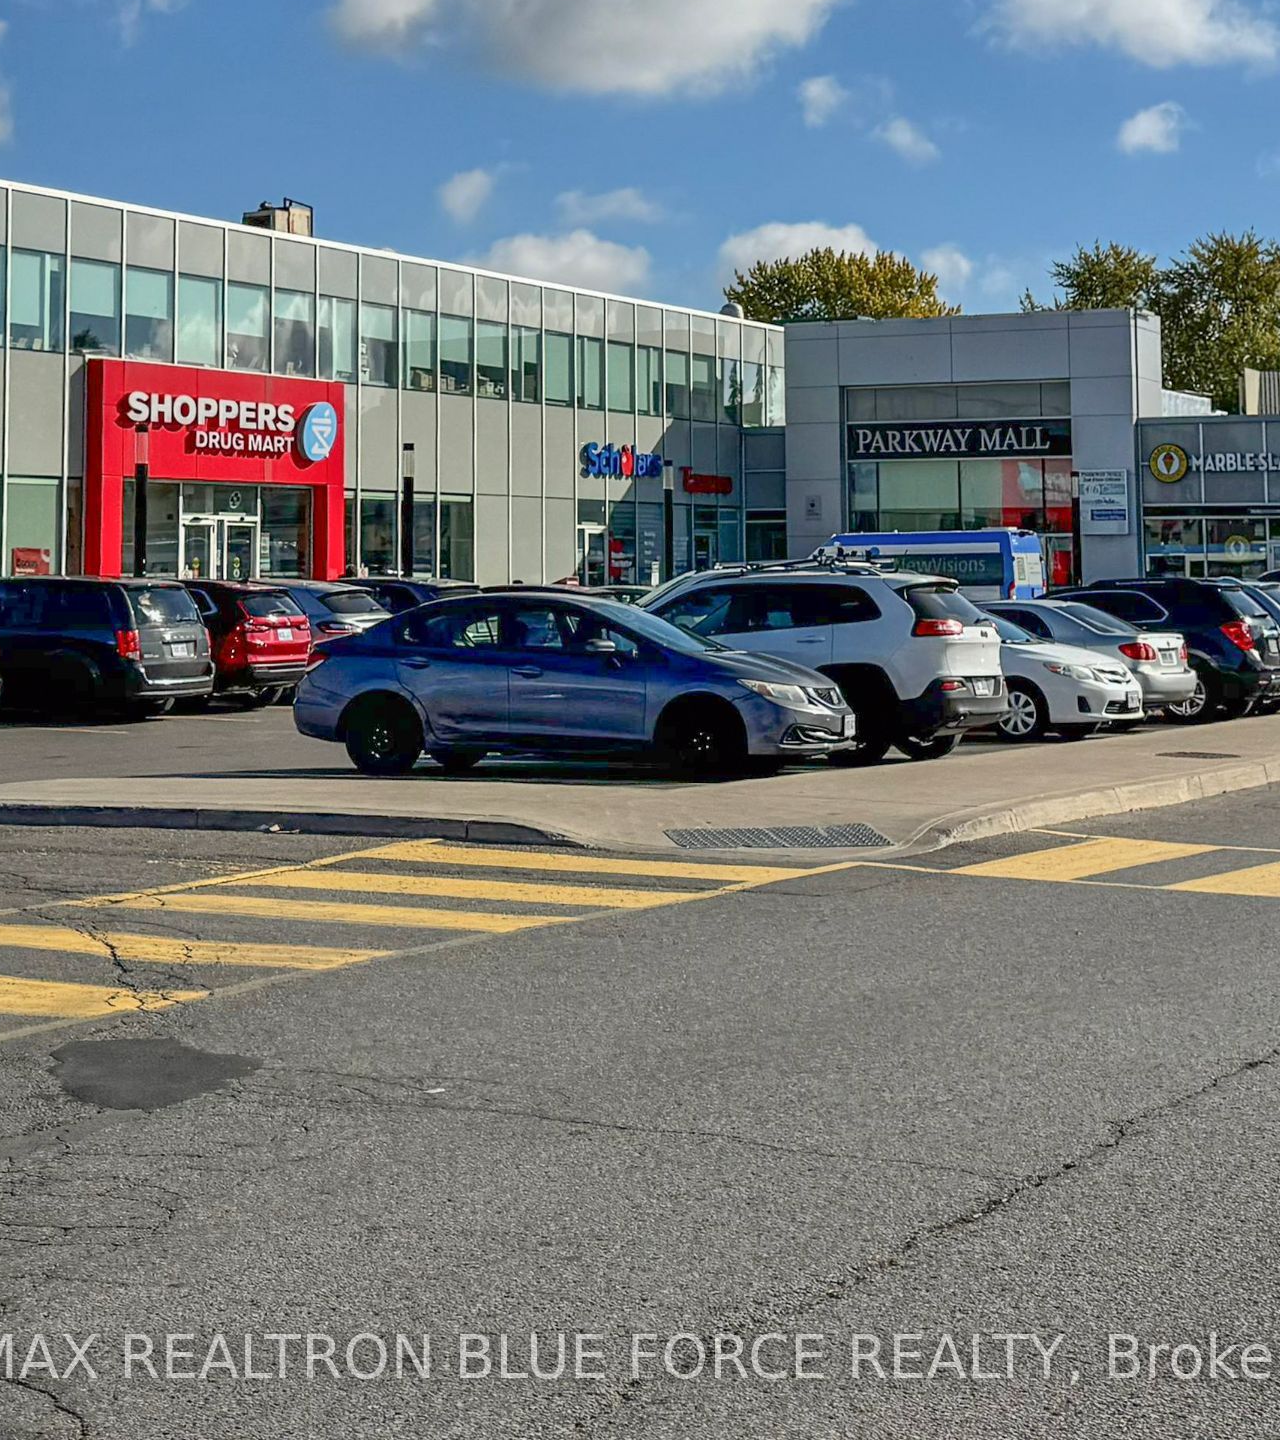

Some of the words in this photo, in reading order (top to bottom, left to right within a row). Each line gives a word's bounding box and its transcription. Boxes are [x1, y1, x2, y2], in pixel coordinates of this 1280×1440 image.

[127, 391, 296, 432] SHOPPERS
[195, 431, 245, 451] DRUG
[248, 434, 294, 453] MART
[856, 428, 971, 453] PARKWAY
[979, 427, 1051, 451] MALL
[587, 441, 663, 478] Scholars
[1191, 453, 1256, 471] MARBLE
